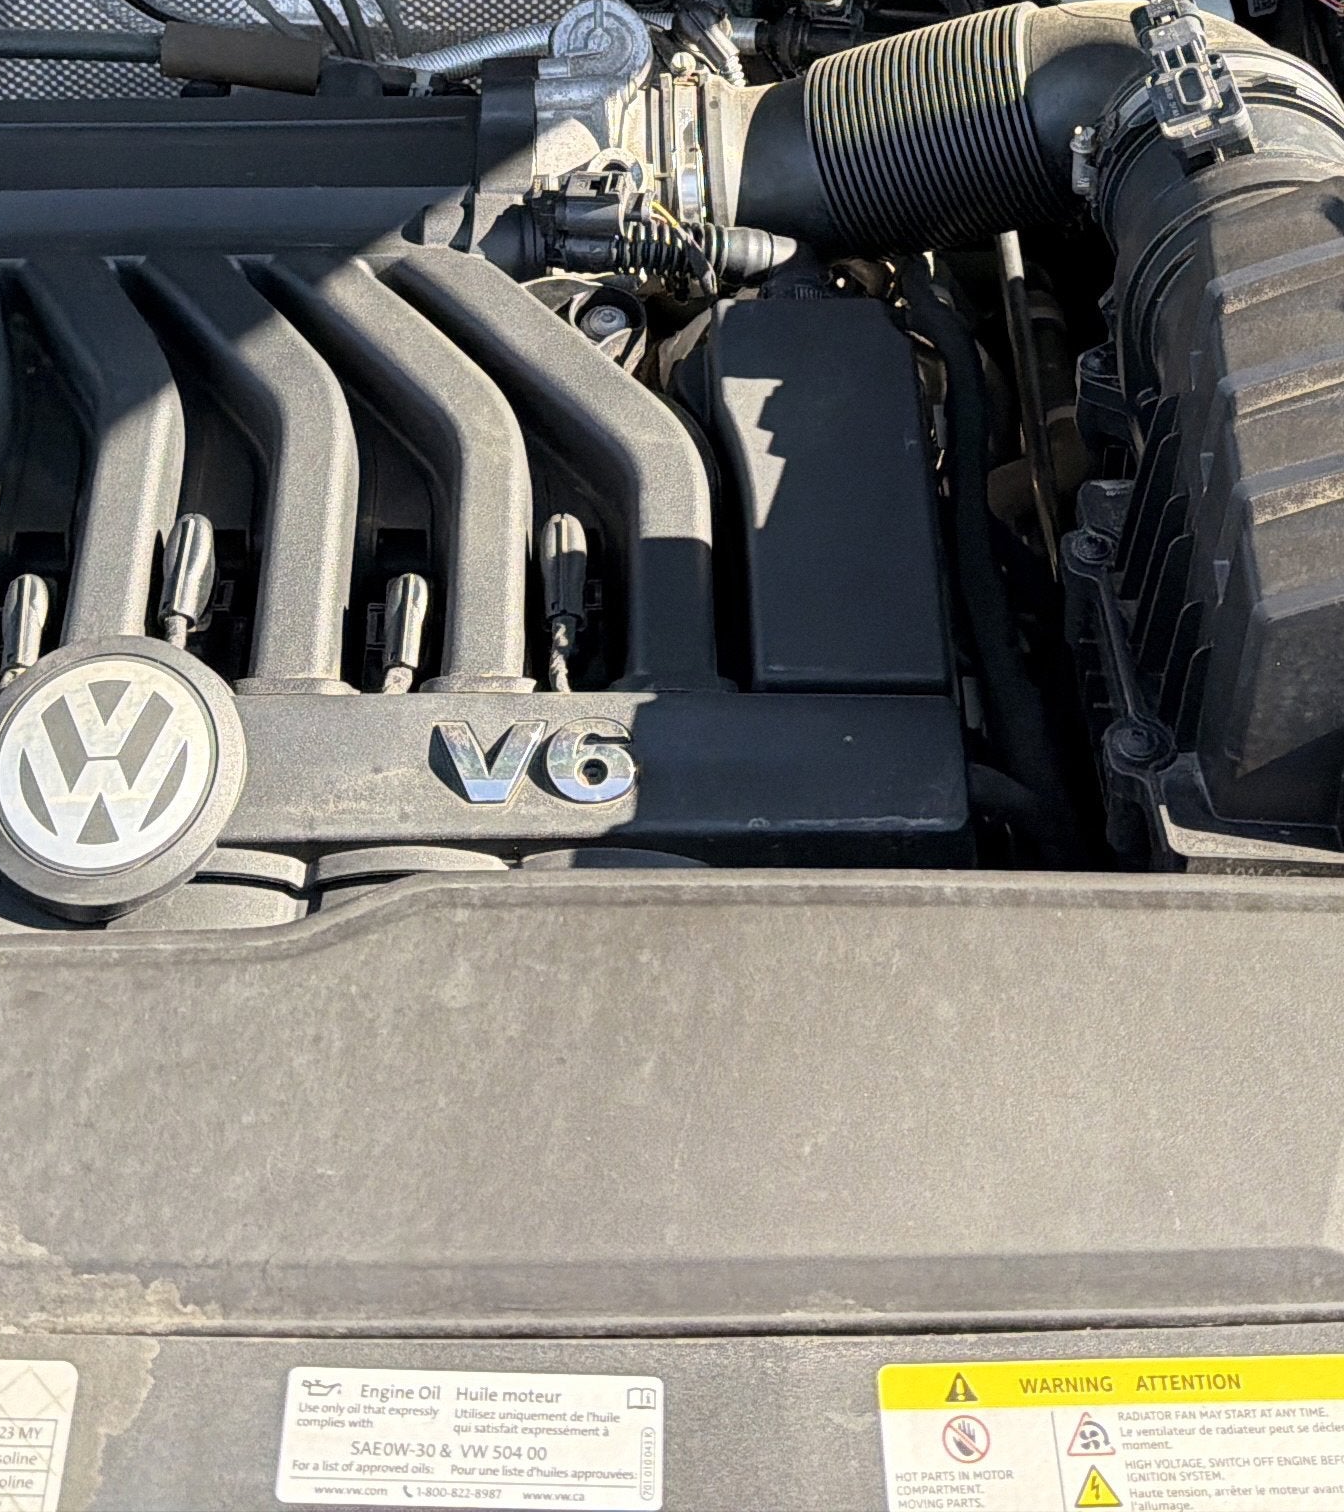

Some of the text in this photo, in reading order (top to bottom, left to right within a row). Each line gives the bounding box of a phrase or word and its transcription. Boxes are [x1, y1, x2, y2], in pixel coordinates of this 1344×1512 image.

[436, 717, 637, 805] V6
[1019, 1374, 1241, 1394] WARNING ATTENTION
[360, 1384, 562, 1404] Engine Oil Huile moteur
[299, 1402, 439, 1420] Use only oil that expressly
[454, 1408, 621, 1424] Utilisez uniquement de l'huile
[1118, 1407, 1329, 1421] RADIATOR FAN MAY START AT ANY TIME.
[296, 1417, 374, 1430] complies with
[453, 1423, 610, 1438] qui satisfait expressément à
[1119, 1427, 1133, 1437] Le
[1136, 1425, 1196, 1437] ventilateur
[1199, 1425, 1213, 1436] de
[1216, 1424, 1266, 1435] radiateur
[1269, 1423, 1294, 1436] peut
[1297, 1425, 1310, 1433] se
[18, 1426, 44, 1440] MY
[439, 1444, 452, 1458] &
[460, 1444, 489, 1459] VW
[492, 1445, 523, 1460] 504
[526, 1446, 548, 1461] 00
[1122, 1441, 1173, 1450] moment.
[292, 1459, 435, 1476] For a list of approved oils:
[643, 1459, 653, 1477] 010
[1125, 1459, 1152, 1470] HIGH
[1208, 1458, 1251, 1468] SWITCH
[1253, 1457, 1274, 1467] OFF
[1277, 1456, 1318, 1467] ENGINE
[450, 1464, 638, 1481] Pour une liste d'huiles approuvées:
[896, 1469, 1014, 1482] HOT PARTS IN MOTOR
[1127, 1471, 1226, 1483] IGNITION SYSTEM.
[314, 1486, 586, 1502] www.vw.com 1-800-822-8987 www.vw.ca
[643, 1480, 653, 1496] 701
[896, 1484, 985, 1496] COMPARTMENT.
[1129, 1488, 1163, 1498] Haute
[1166, 1487, 1211, 1499] tension,
[1214, 1485, 1254, 1496] arrêter
[1256, 1486, 1266, 1496] le
[1269, 1485, 1311, 1495] moteur
[1313, 1484, 1344, 1494] avant
[898, 1497, 985, 1510] MOVING PARTS.
